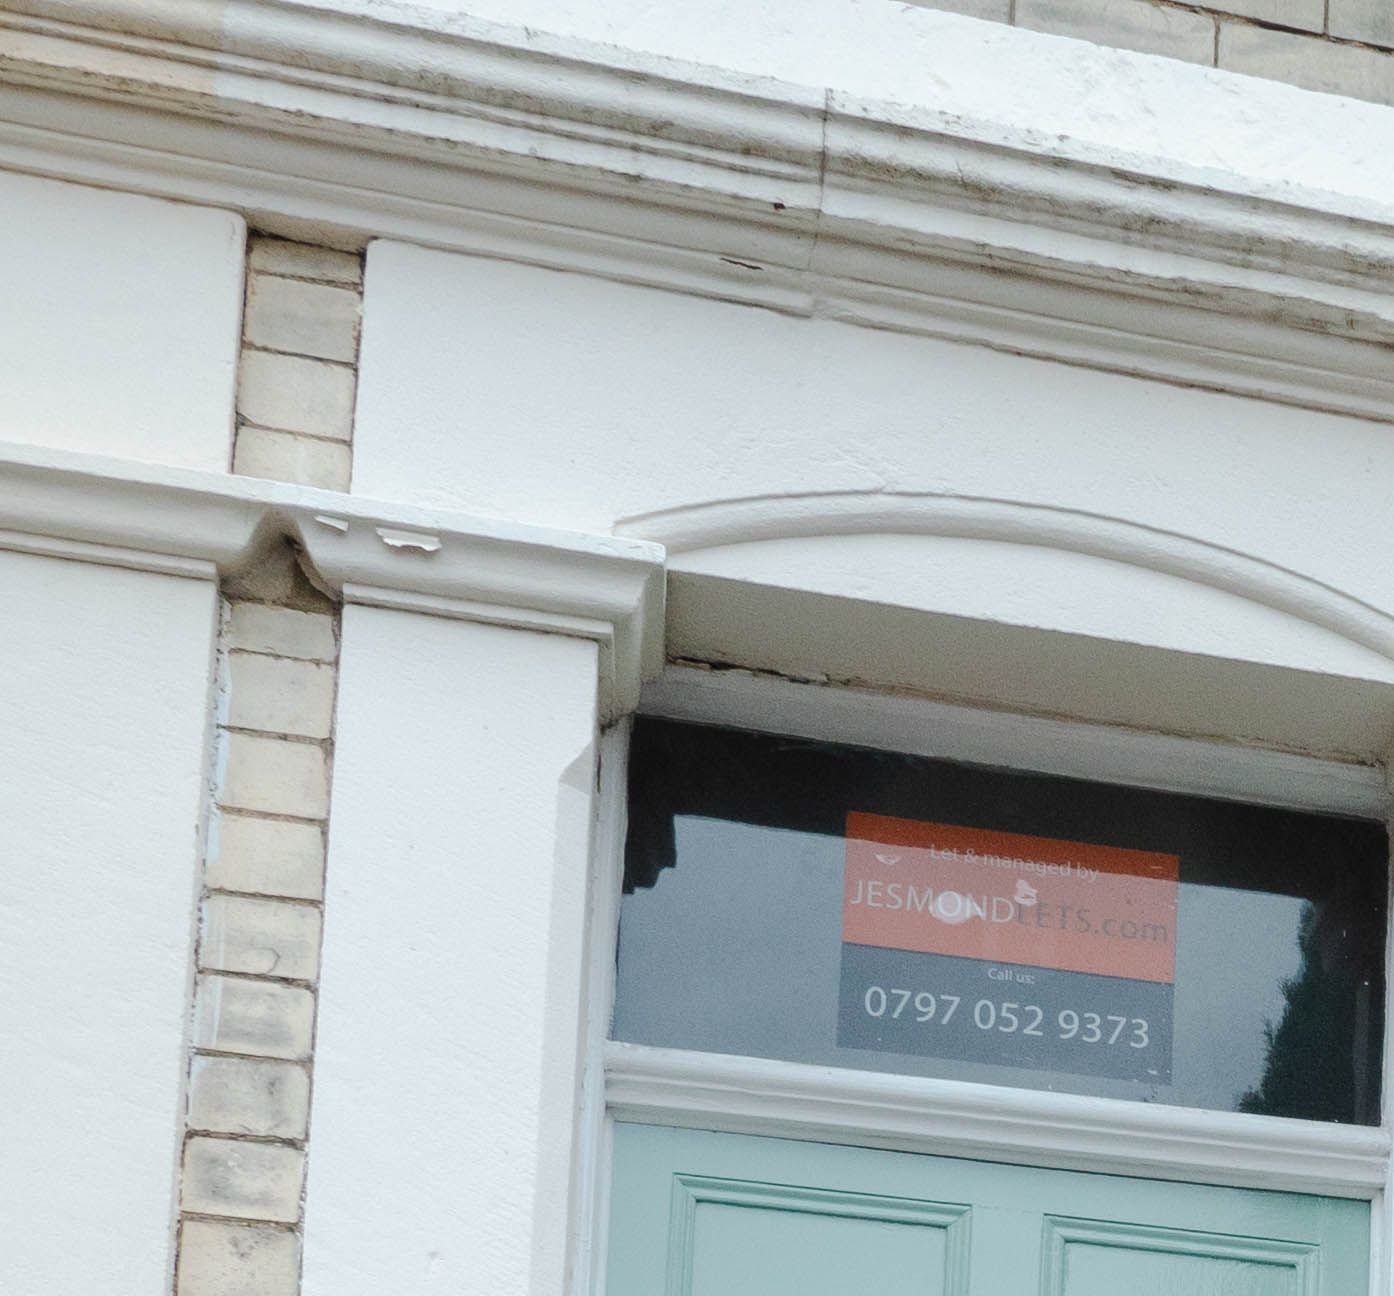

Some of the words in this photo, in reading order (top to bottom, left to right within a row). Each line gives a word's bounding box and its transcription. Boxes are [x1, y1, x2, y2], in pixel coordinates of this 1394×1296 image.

[930, 843, 961, 862] Let
[963, 848, 977, 865] &
[983, 853, 1072, 879] managed
[1076, 863, 1099, 882] by
[987, 967, 1013, 982] Call
[1015, 970, 1035, 985] us:
[864, 986, 961, 1025] 0797
[973, 999, 1045, 1036] 052
[1057, 1009, 1150, 1049] 9373
